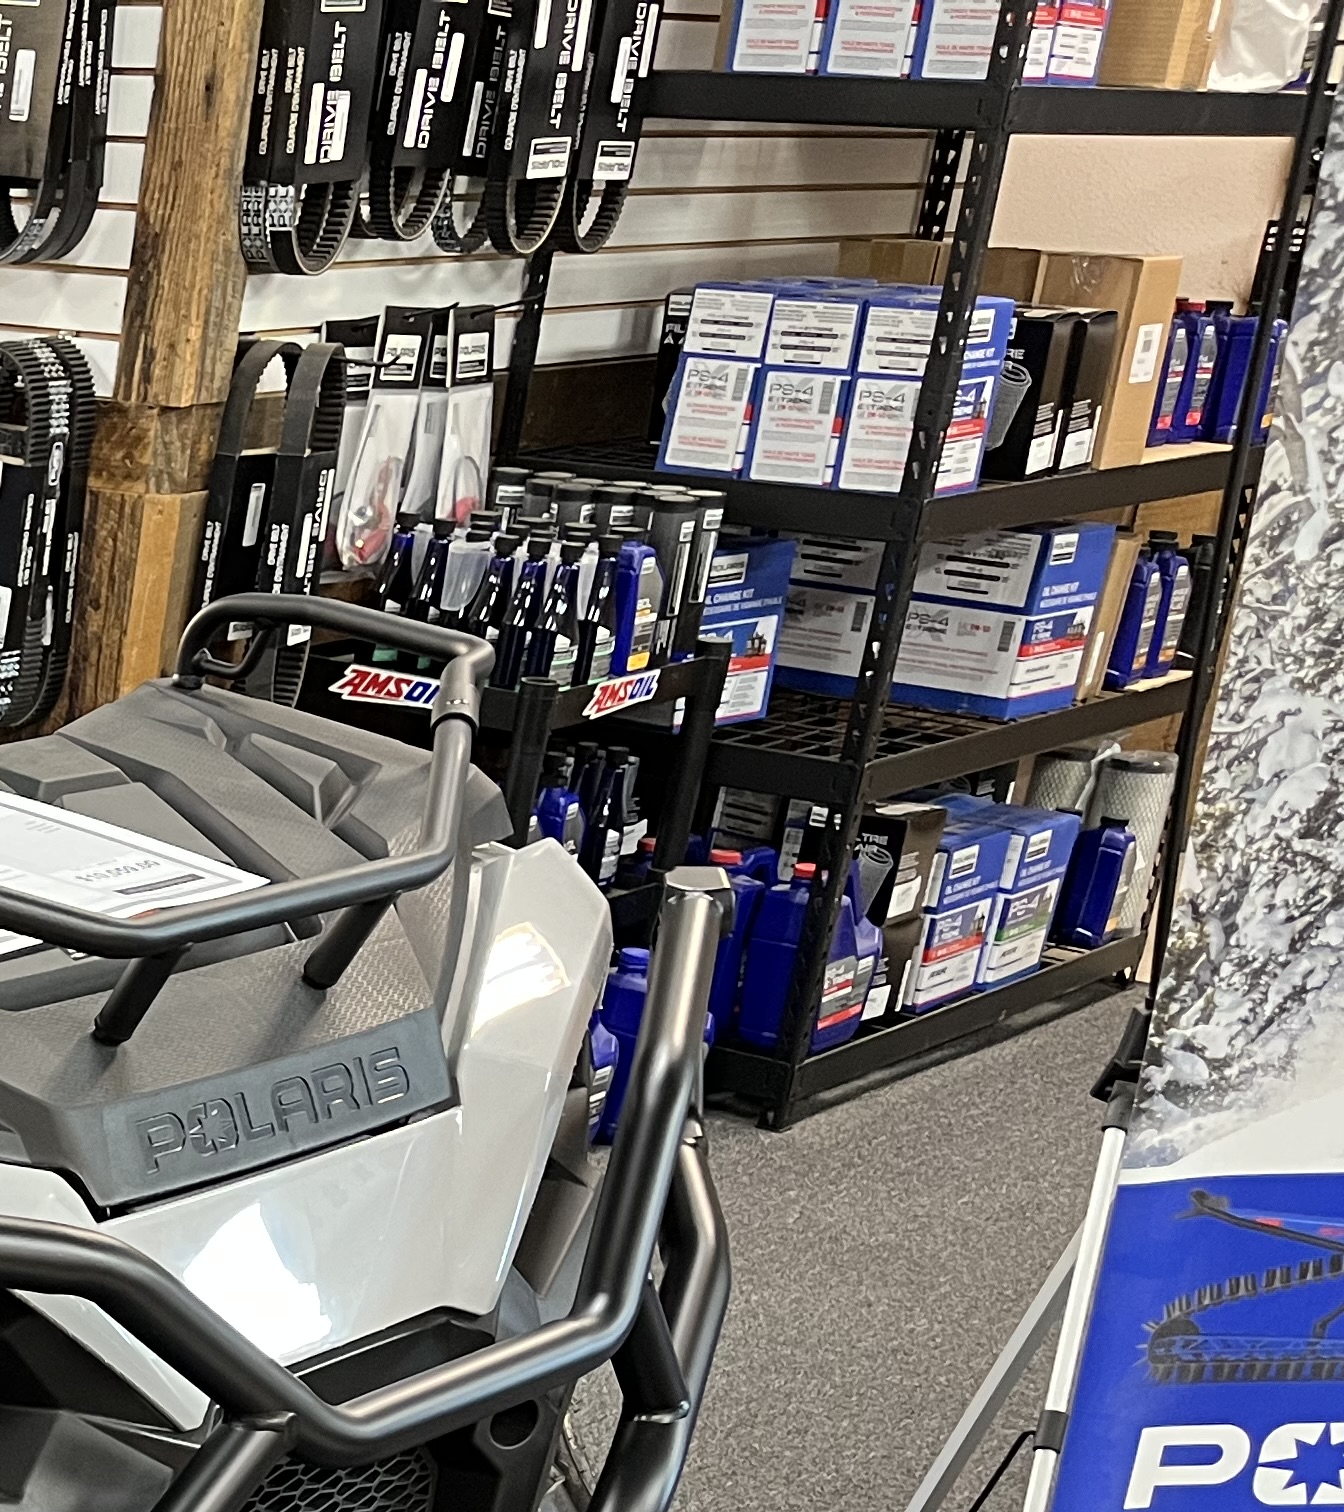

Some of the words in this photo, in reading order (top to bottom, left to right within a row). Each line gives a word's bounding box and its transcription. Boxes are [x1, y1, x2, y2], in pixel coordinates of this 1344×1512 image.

[329, 20, 347, 82] BELT
[558, 0, 577, 66] DRIVE
[627, 2, 647, 71] DRIVE
[417, 77, 440, 148] DRIVE
[431, 10, 451, 69] BELT
[475, 90, 496, 158] DRIVE
[489, 25, 506, 82] BELT
[549, 72, 567, 130] BELT
[616, 78, 634, 133] BELT
[687, 369, 729, 383] PS-4
[769, 383, 814, 396] PS-4
[859, 390, 905, 403] PS-4
[907, 613, 949, 626] PS-4
[338, 668, 440, 705] AMSOI
[590, 674, 659, 714] AMSOIL
[136, 1046, 410, 1175] POLARIS
